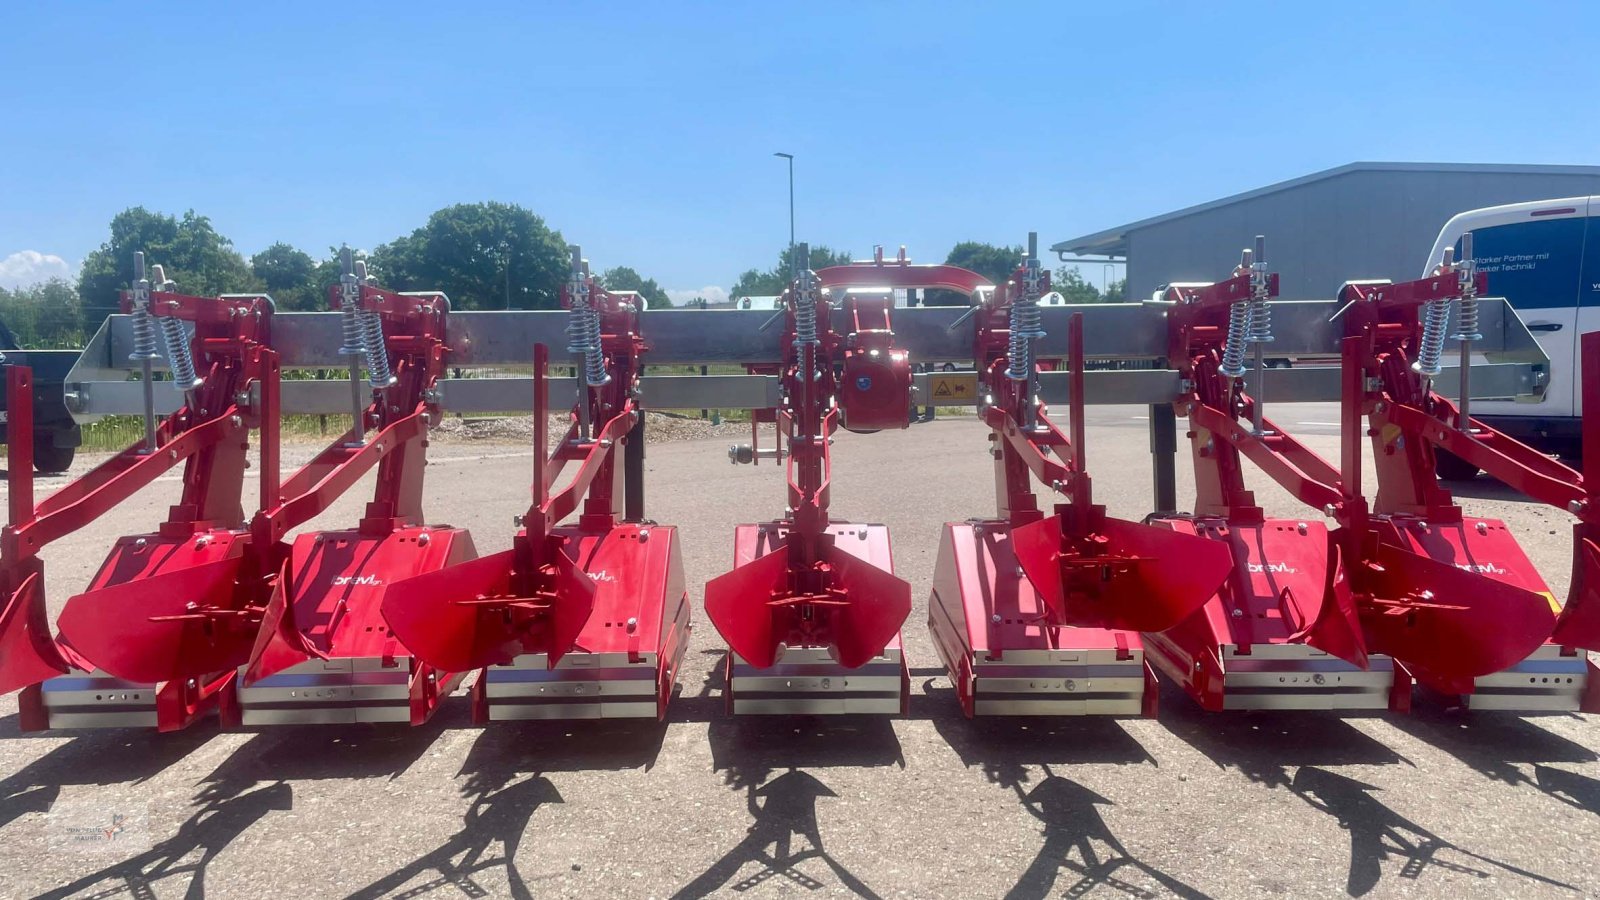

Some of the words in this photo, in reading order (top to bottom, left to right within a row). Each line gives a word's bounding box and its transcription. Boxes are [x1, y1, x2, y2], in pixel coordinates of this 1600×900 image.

[1474, 256, 1501, 264] Starker
[1503, 254, 1534, 262] Partner
[1476, 265, 1499, 273] tarker
